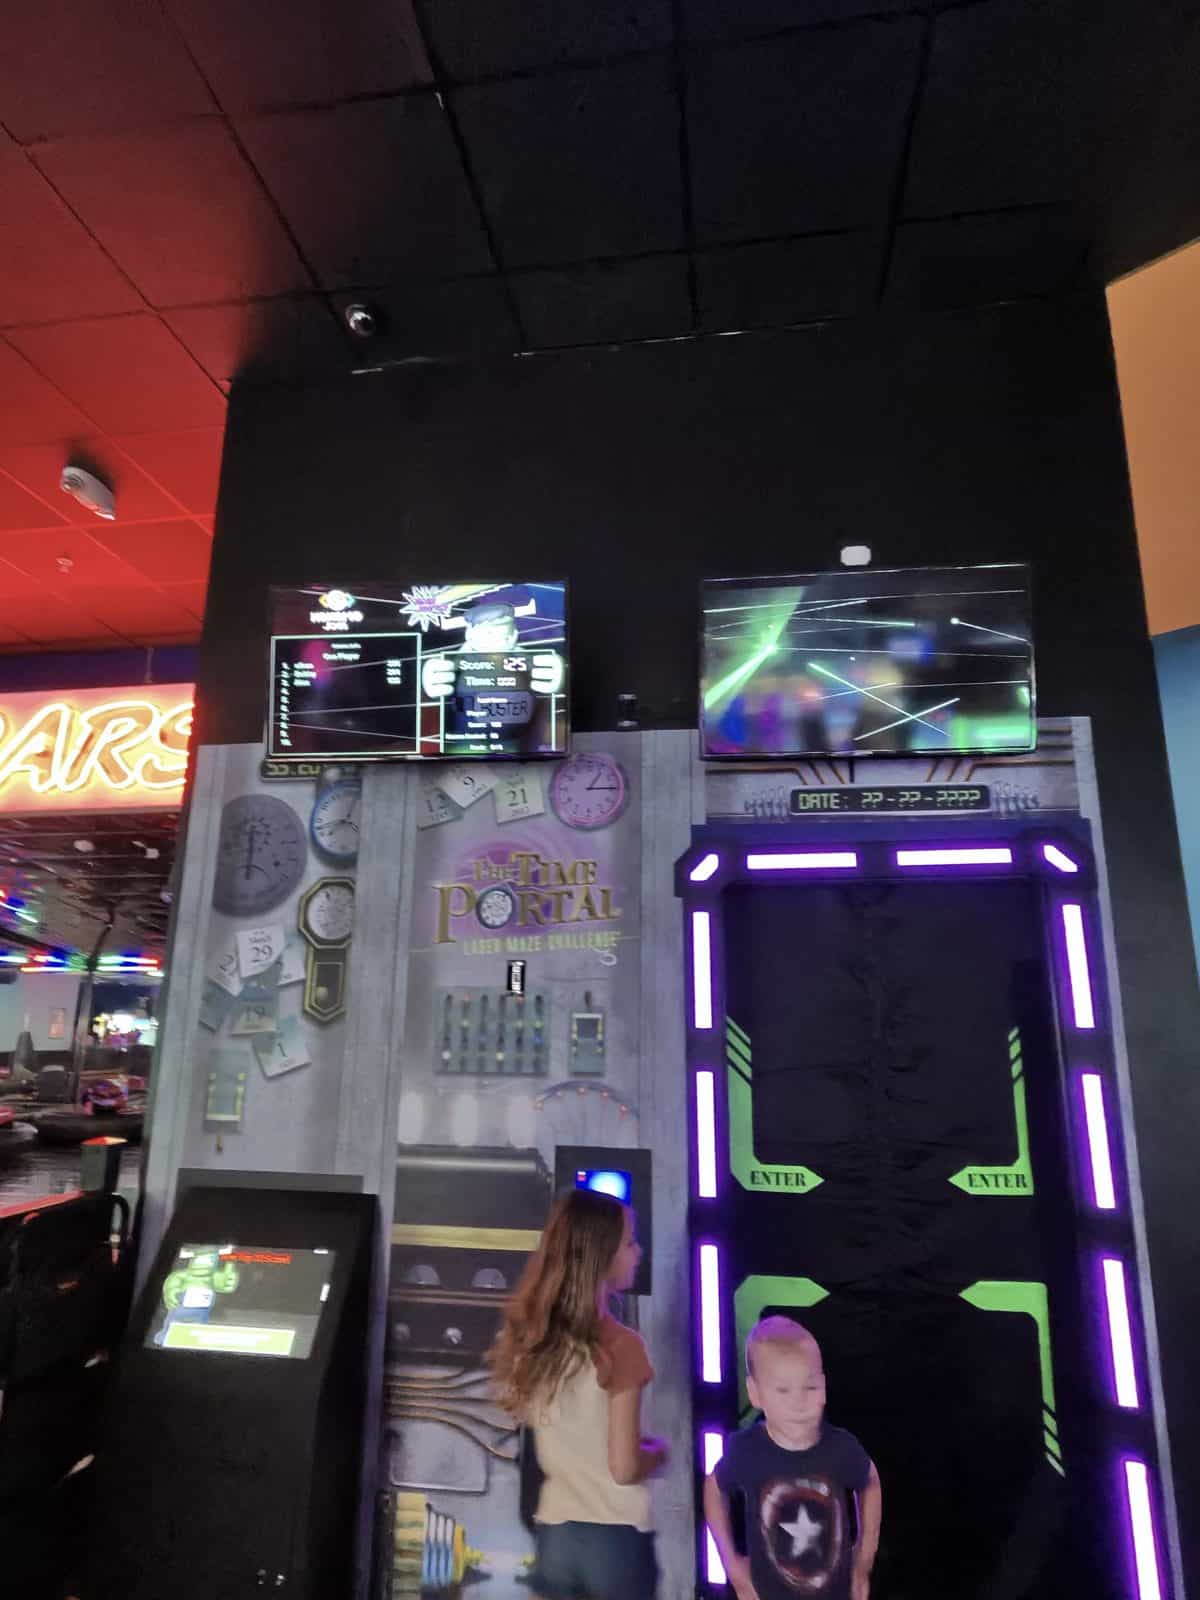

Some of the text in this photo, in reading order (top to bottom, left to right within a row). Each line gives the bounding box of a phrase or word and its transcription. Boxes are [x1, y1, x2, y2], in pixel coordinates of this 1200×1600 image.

[0, 700, 195, 793] ARS
[505, 787, 529, 807] 21
[510, 851, 598, 887] TIME
[432, 880, 622, 945] PORTAL
[750, 1170, 808, 1188] ENTER
[967, 1172, 1029, 1189] ENTER
